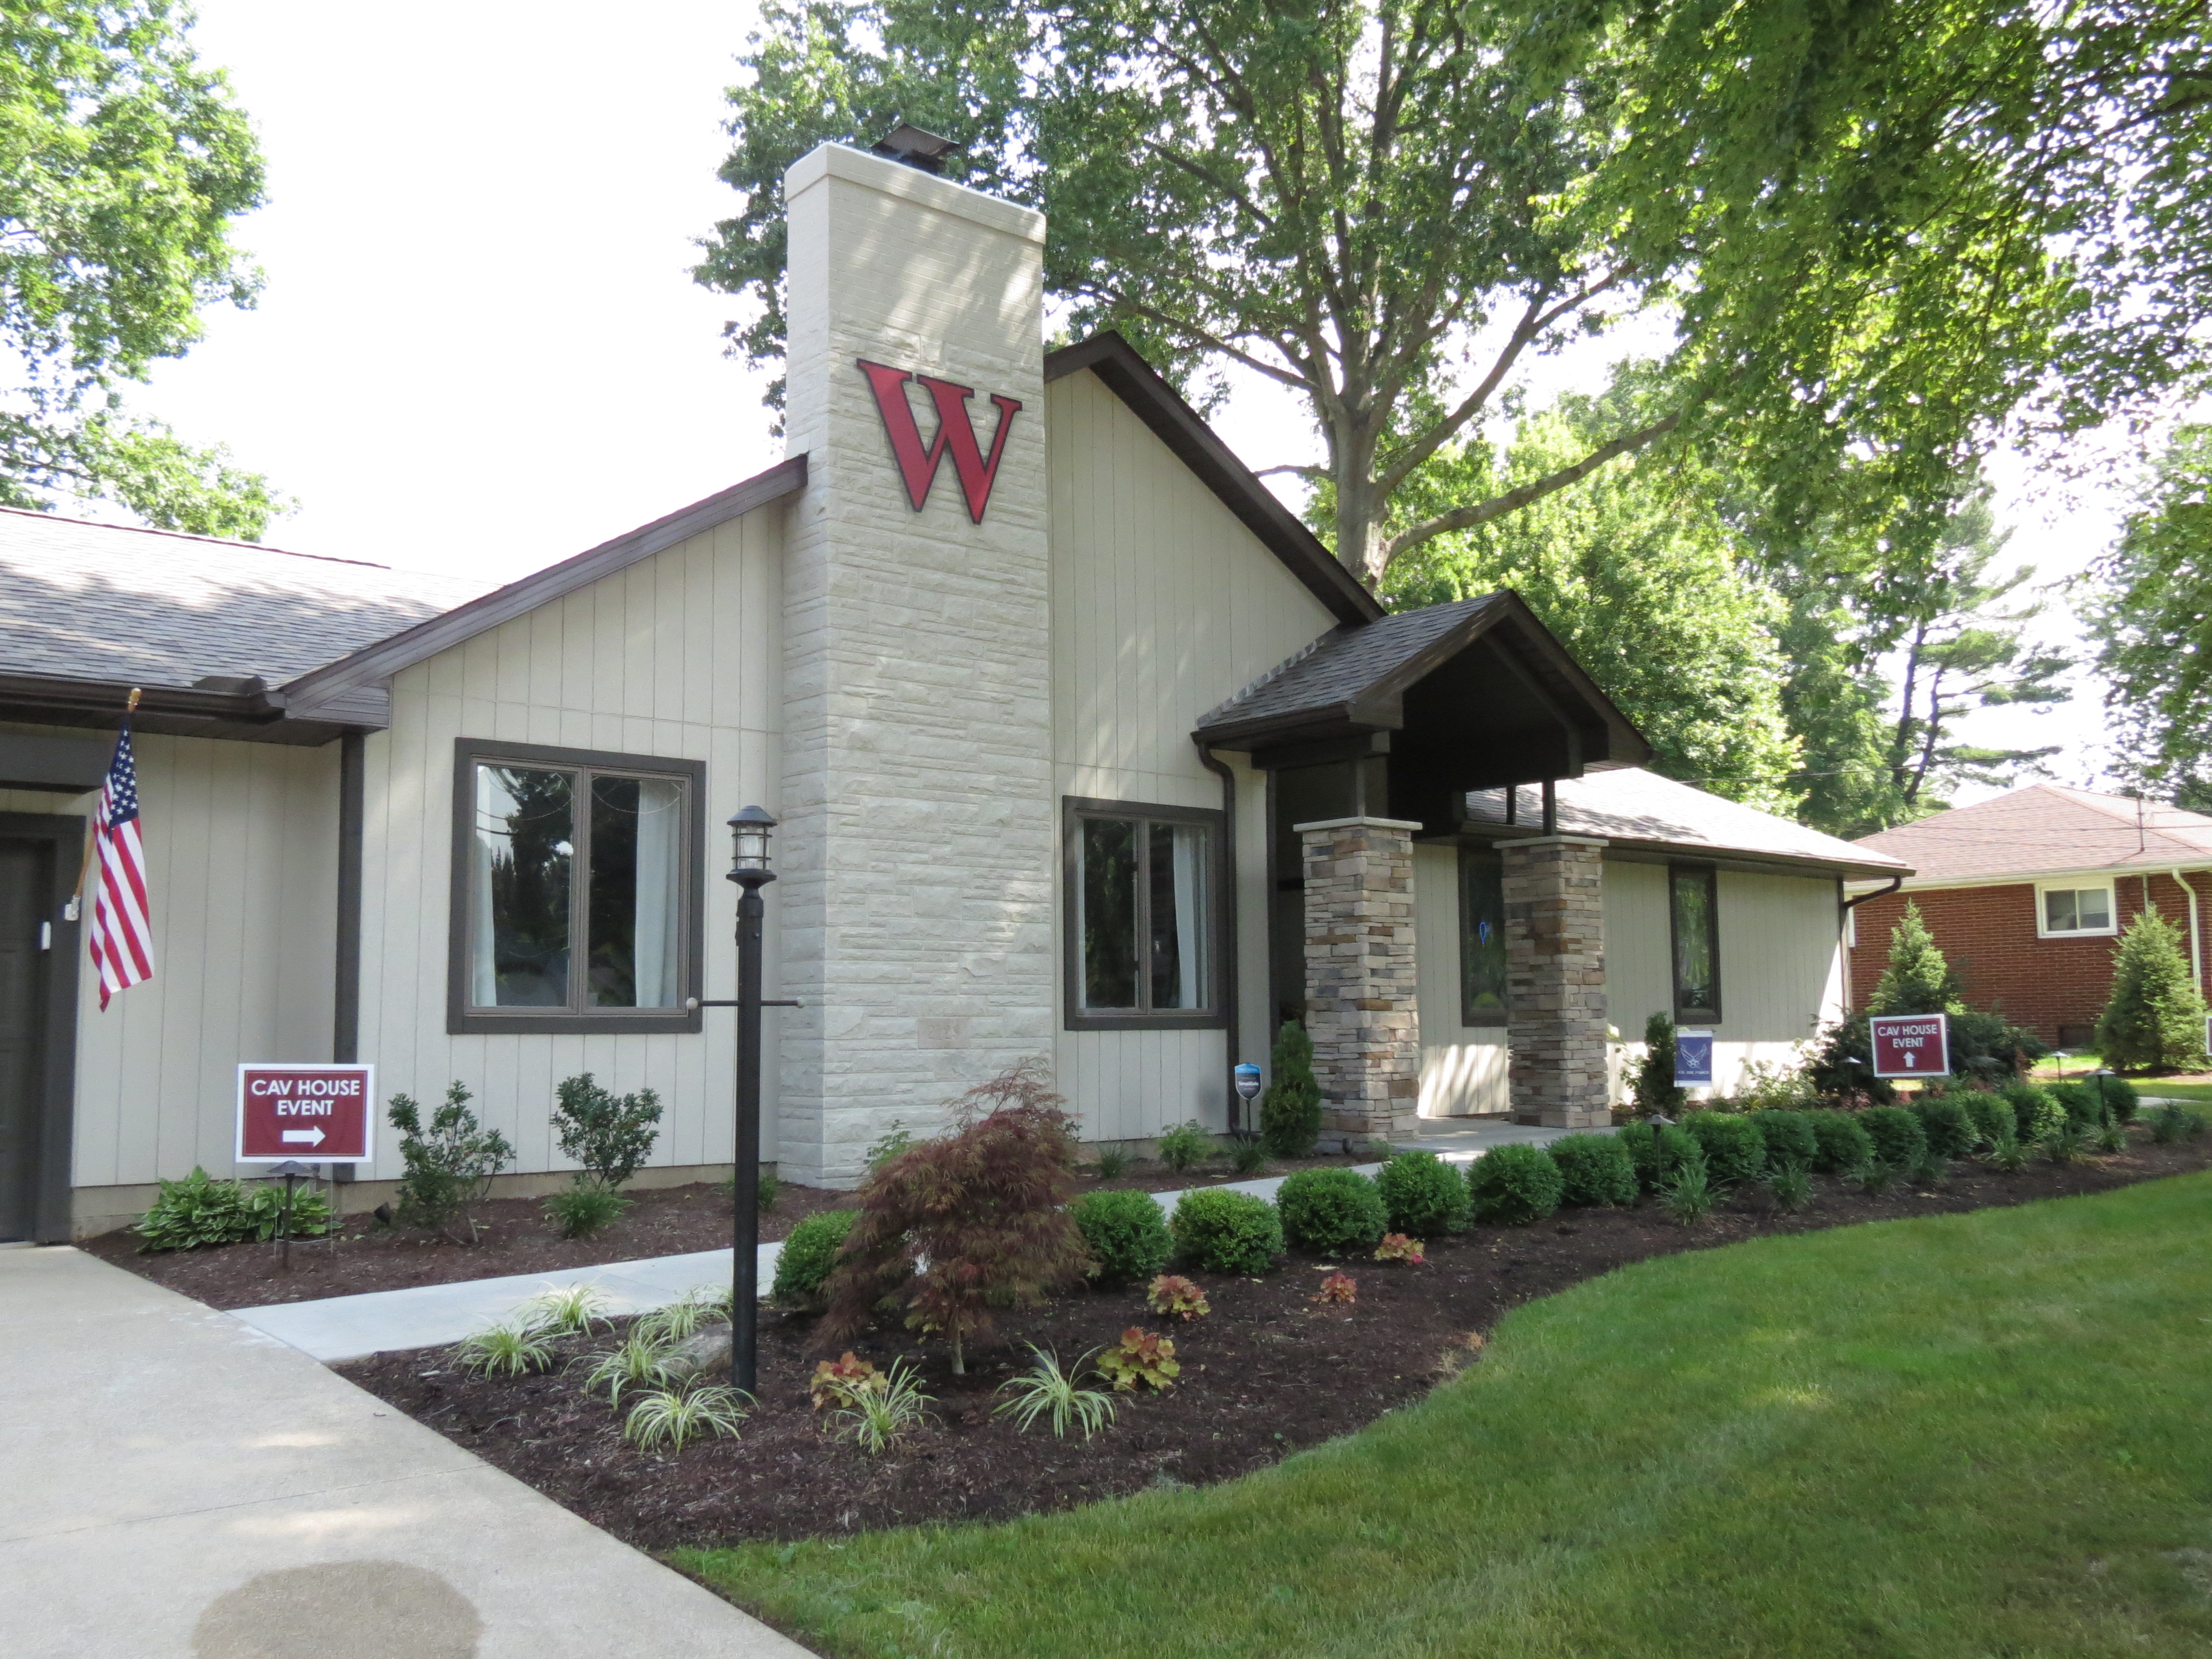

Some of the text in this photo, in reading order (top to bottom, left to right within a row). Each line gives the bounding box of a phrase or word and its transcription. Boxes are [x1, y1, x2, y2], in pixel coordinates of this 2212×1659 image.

[856, 358, 1022, 525] W
[1877, 1024, 1938, 1036] CAV HOUSE
[1892, 1037, 1924, 1048] EVENT
[251, 1079, 360, 1095] CAV HOUSE
[277, 1100, 335, 1115] EVENT
